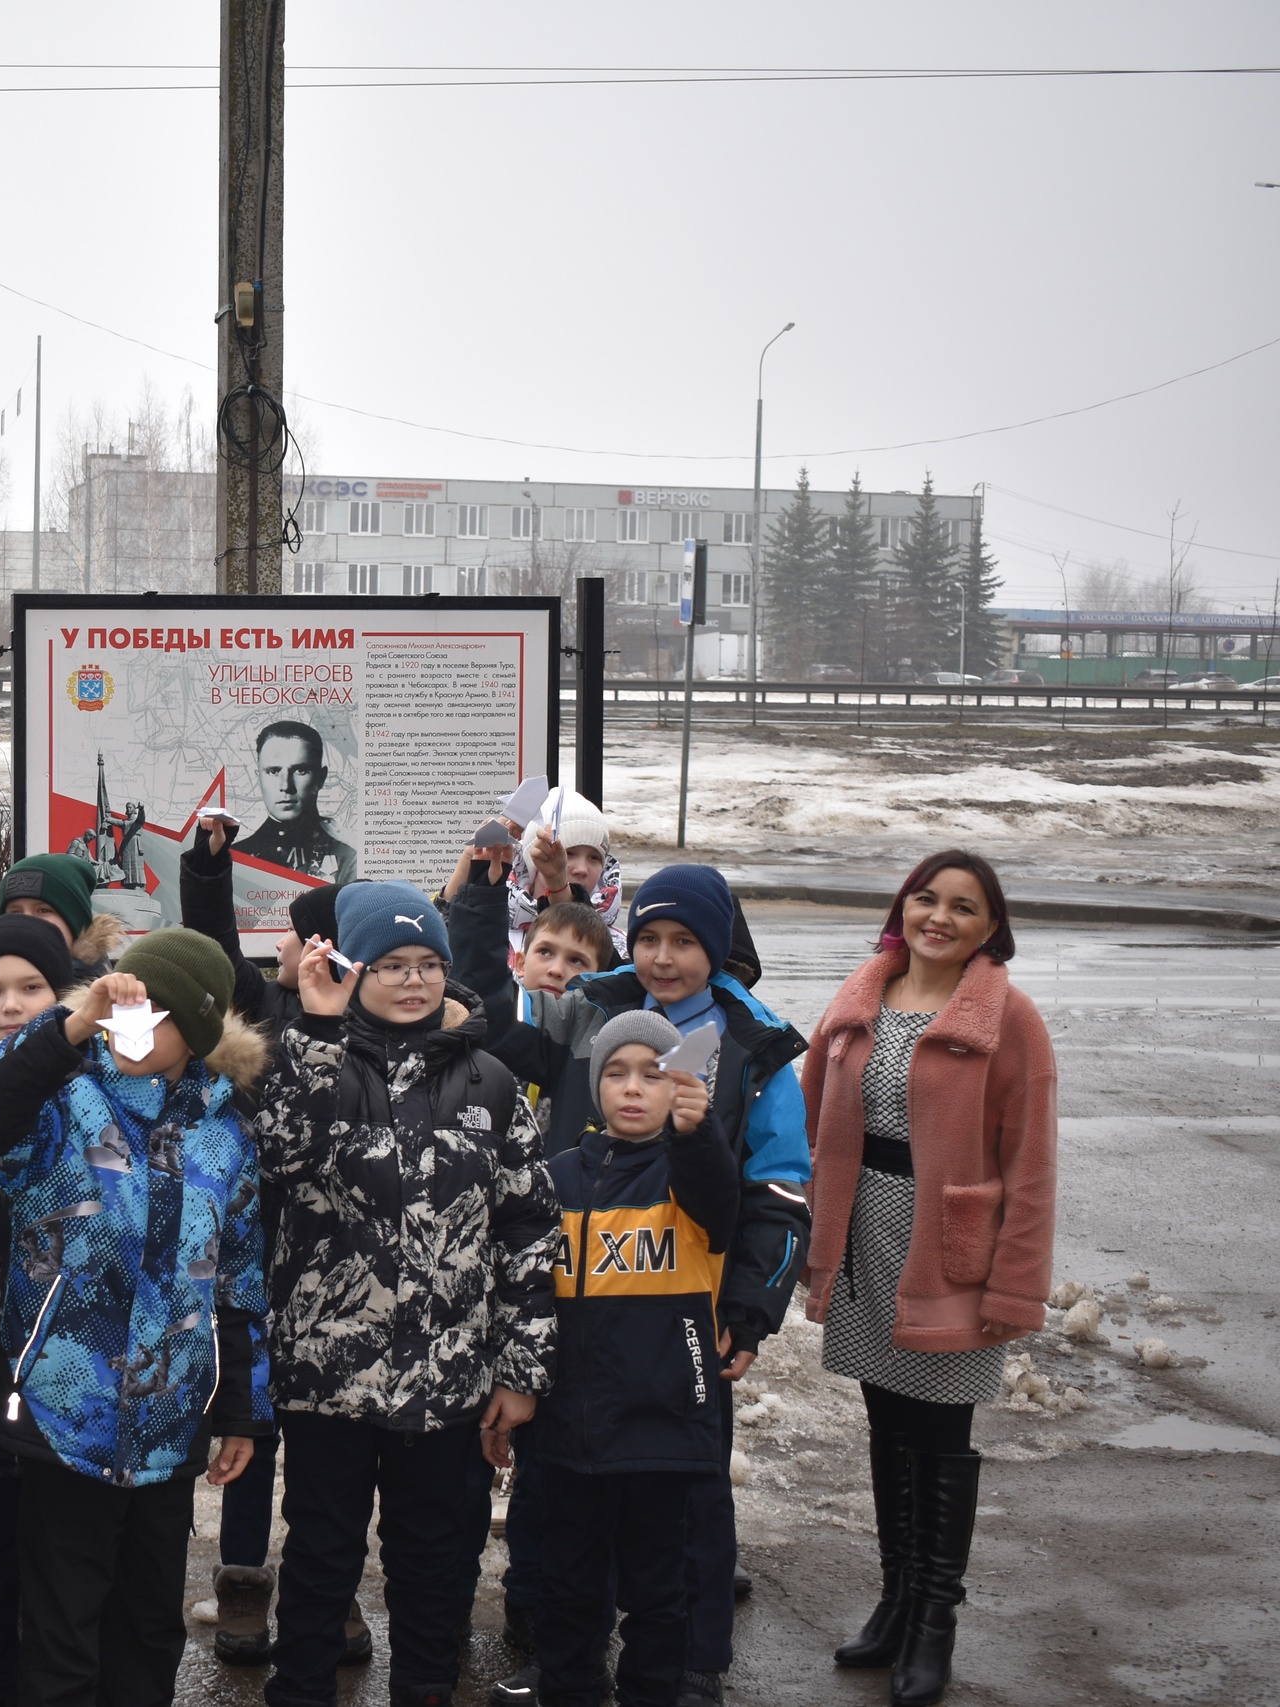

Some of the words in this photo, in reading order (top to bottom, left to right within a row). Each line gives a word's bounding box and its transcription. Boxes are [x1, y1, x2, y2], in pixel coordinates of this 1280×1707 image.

[283, 481, 368, 497] АКСЭС
[634, 491, 711, 507] ВЕРТЭКС
[61, 628, 79, 649] У
[88, 628, 210, 652] ПОБЕДЫ
[221, 628, 283, 649] ЕСТЬ
[292, 629, 354, 648] ИМЯ
[435, 642, 485, 650] Александрович
[367, 652, 386, 660] Герой
[365, 661, 391, 669] Родился
[470, 661, 496, 670] Верхняя
[499, 661, 515, 670] Тура,
[209, 664, 277, 684] УЛИЦЫ
[285, 664, 352, 682] ГЕРОЕВ
[408, 681, 448, 689] Чебоксарах.
[212, 688, 222, 704] В
[229, 687, 352, 704] ЧЕБОКСАРАХ
[404, 691, 427, 699] службу
[434, 691, 463, 699] Красную
[464, 691, 489, 699] Армию.
[403, 711, 428, 719] октябре
[365, 721, 387, 729] фронт.
[478, 751, 510, 759] спрыгнуть
[364, 779, 392, 788] дерзкий
[402, 808, 456, 817] аэрофотосъемку
[373, 818, 402, 827] глубоком
[424, 876, 442, 885] Героя
[247, 890, 310, 900] САПОЖНИ
[234, 907, 289, 917] АЛЕКСАНД
[466, 1106, 481, 1114] THE
[457, 1112, 481, 1121] NORTH
[462, 1120, 481, 1129] FACE
[683, 1318, 706, 1404] ACEREAPER
